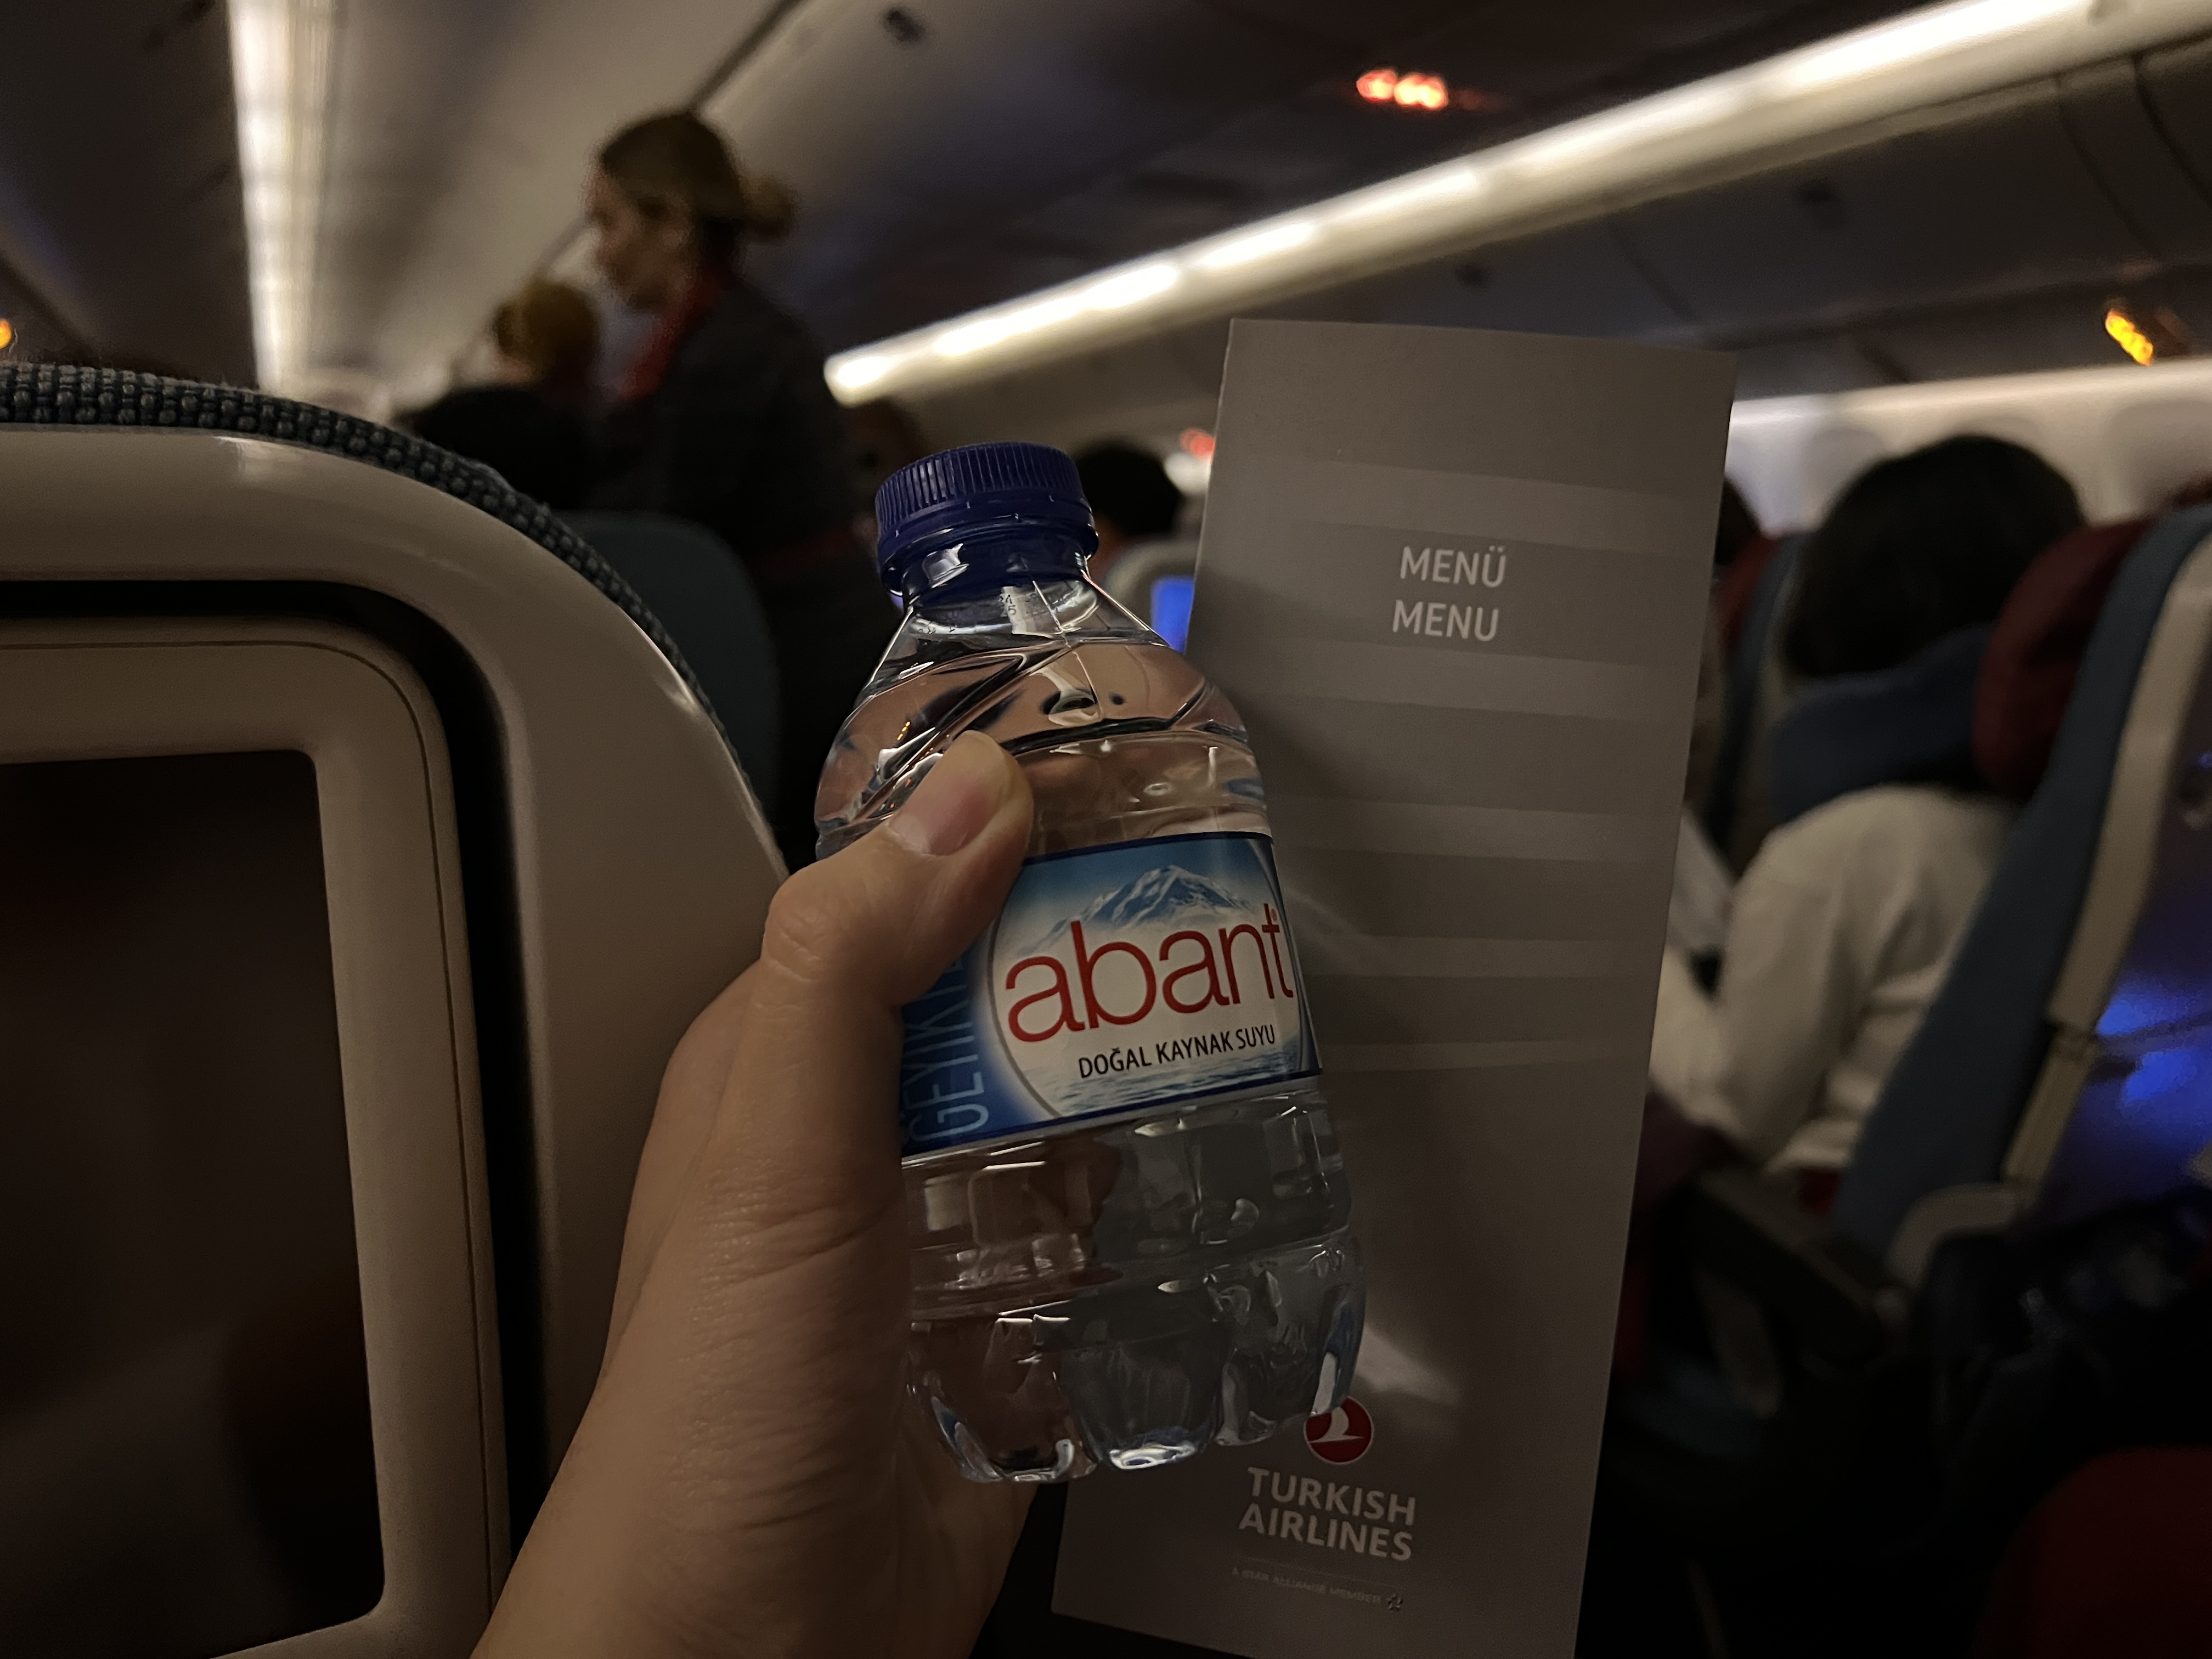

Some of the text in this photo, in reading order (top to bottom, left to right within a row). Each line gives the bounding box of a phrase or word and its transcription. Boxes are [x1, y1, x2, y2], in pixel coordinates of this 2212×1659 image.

[1400, 545, 1506, 588] MENÜ
[1392, 600, 1499, 641] MENU
[1005, 902, 1294, 1042] abant
[1079, 1024, 1276, 1079] DOĞAL KAYNAK SUYU
[1248, 1466, 1417, 1526] TURKISH
[1238, 1502, 1413, 1562] AIRLINES
